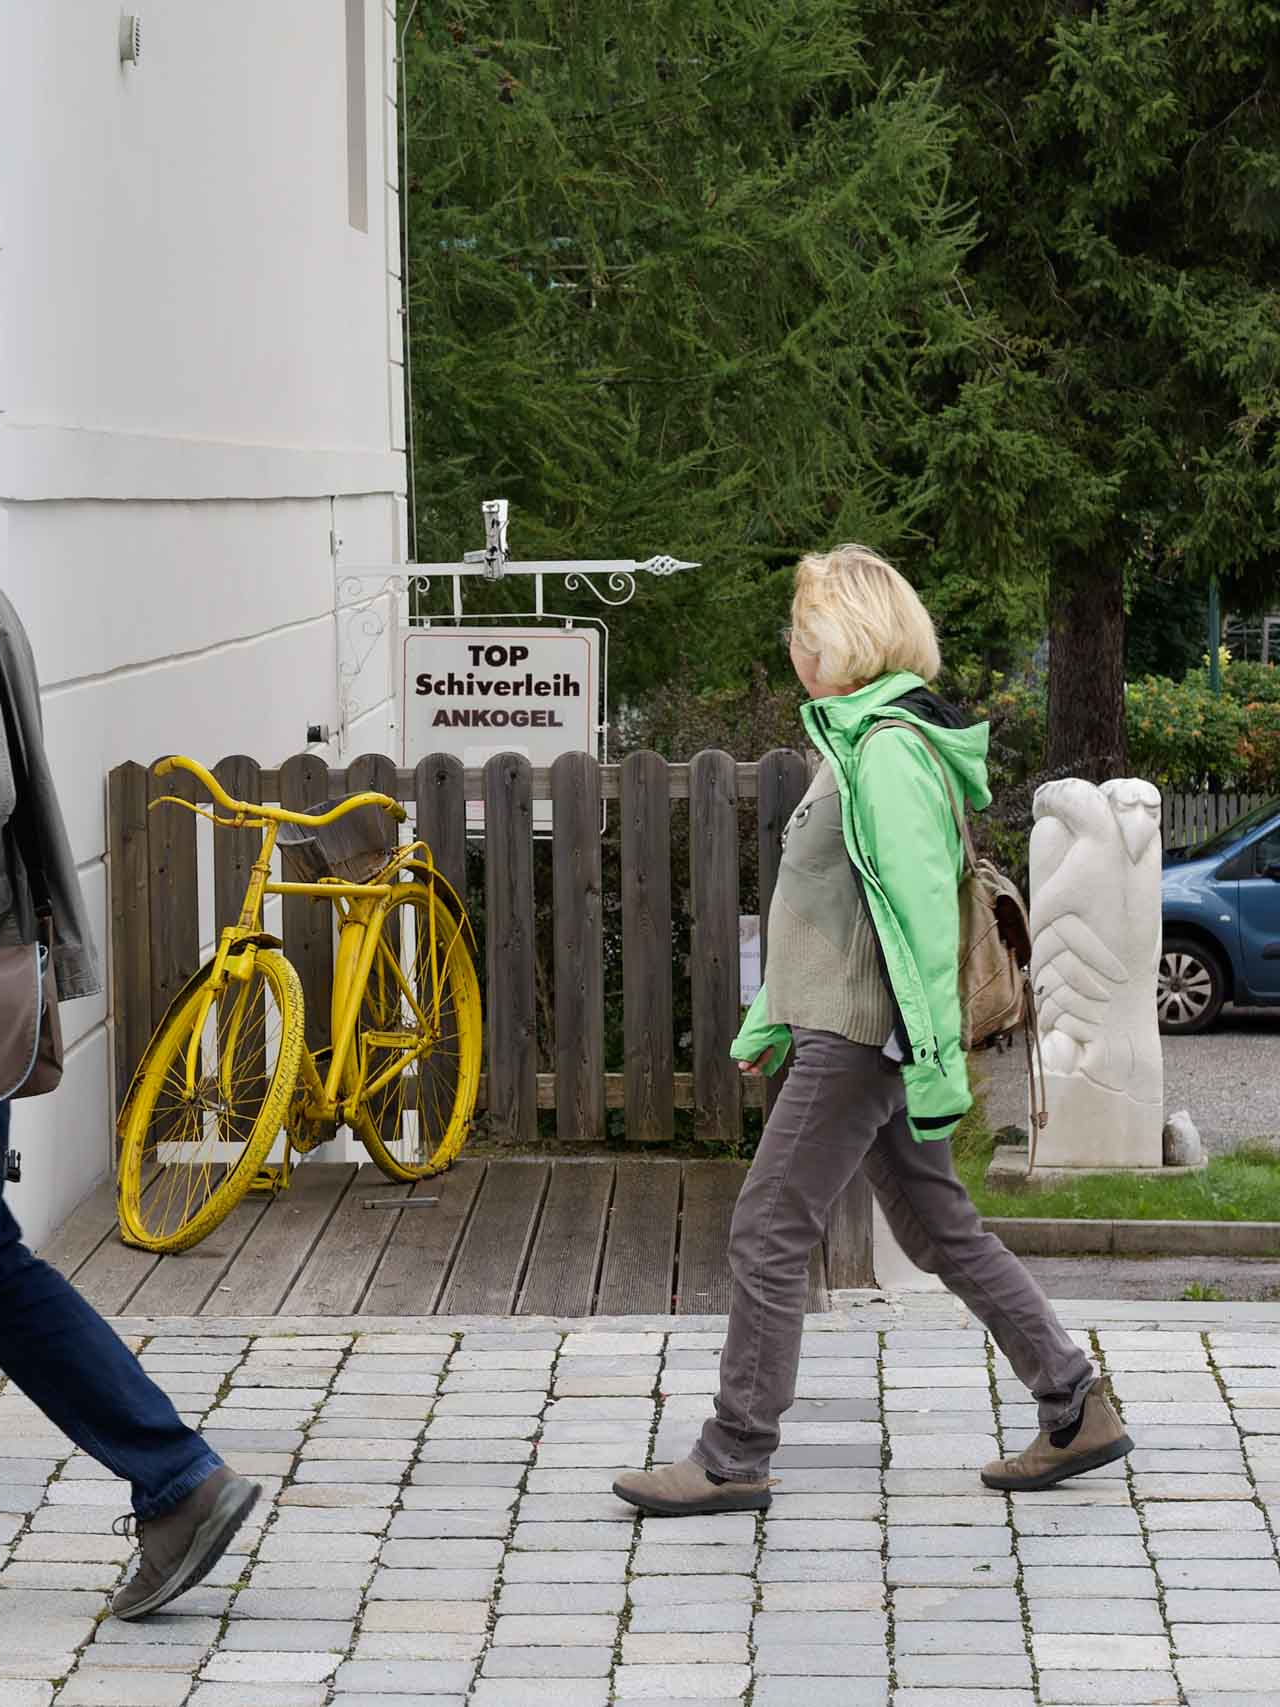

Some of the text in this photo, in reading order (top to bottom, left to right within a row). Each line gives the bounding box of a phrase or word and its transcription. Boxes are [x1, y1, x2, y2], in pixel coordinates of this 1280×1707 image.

[468, 645, 529, 667] TOP
[415, 673, 580, 697] Schiverleih
[432, 709, 563, 727] ANKOGEL
